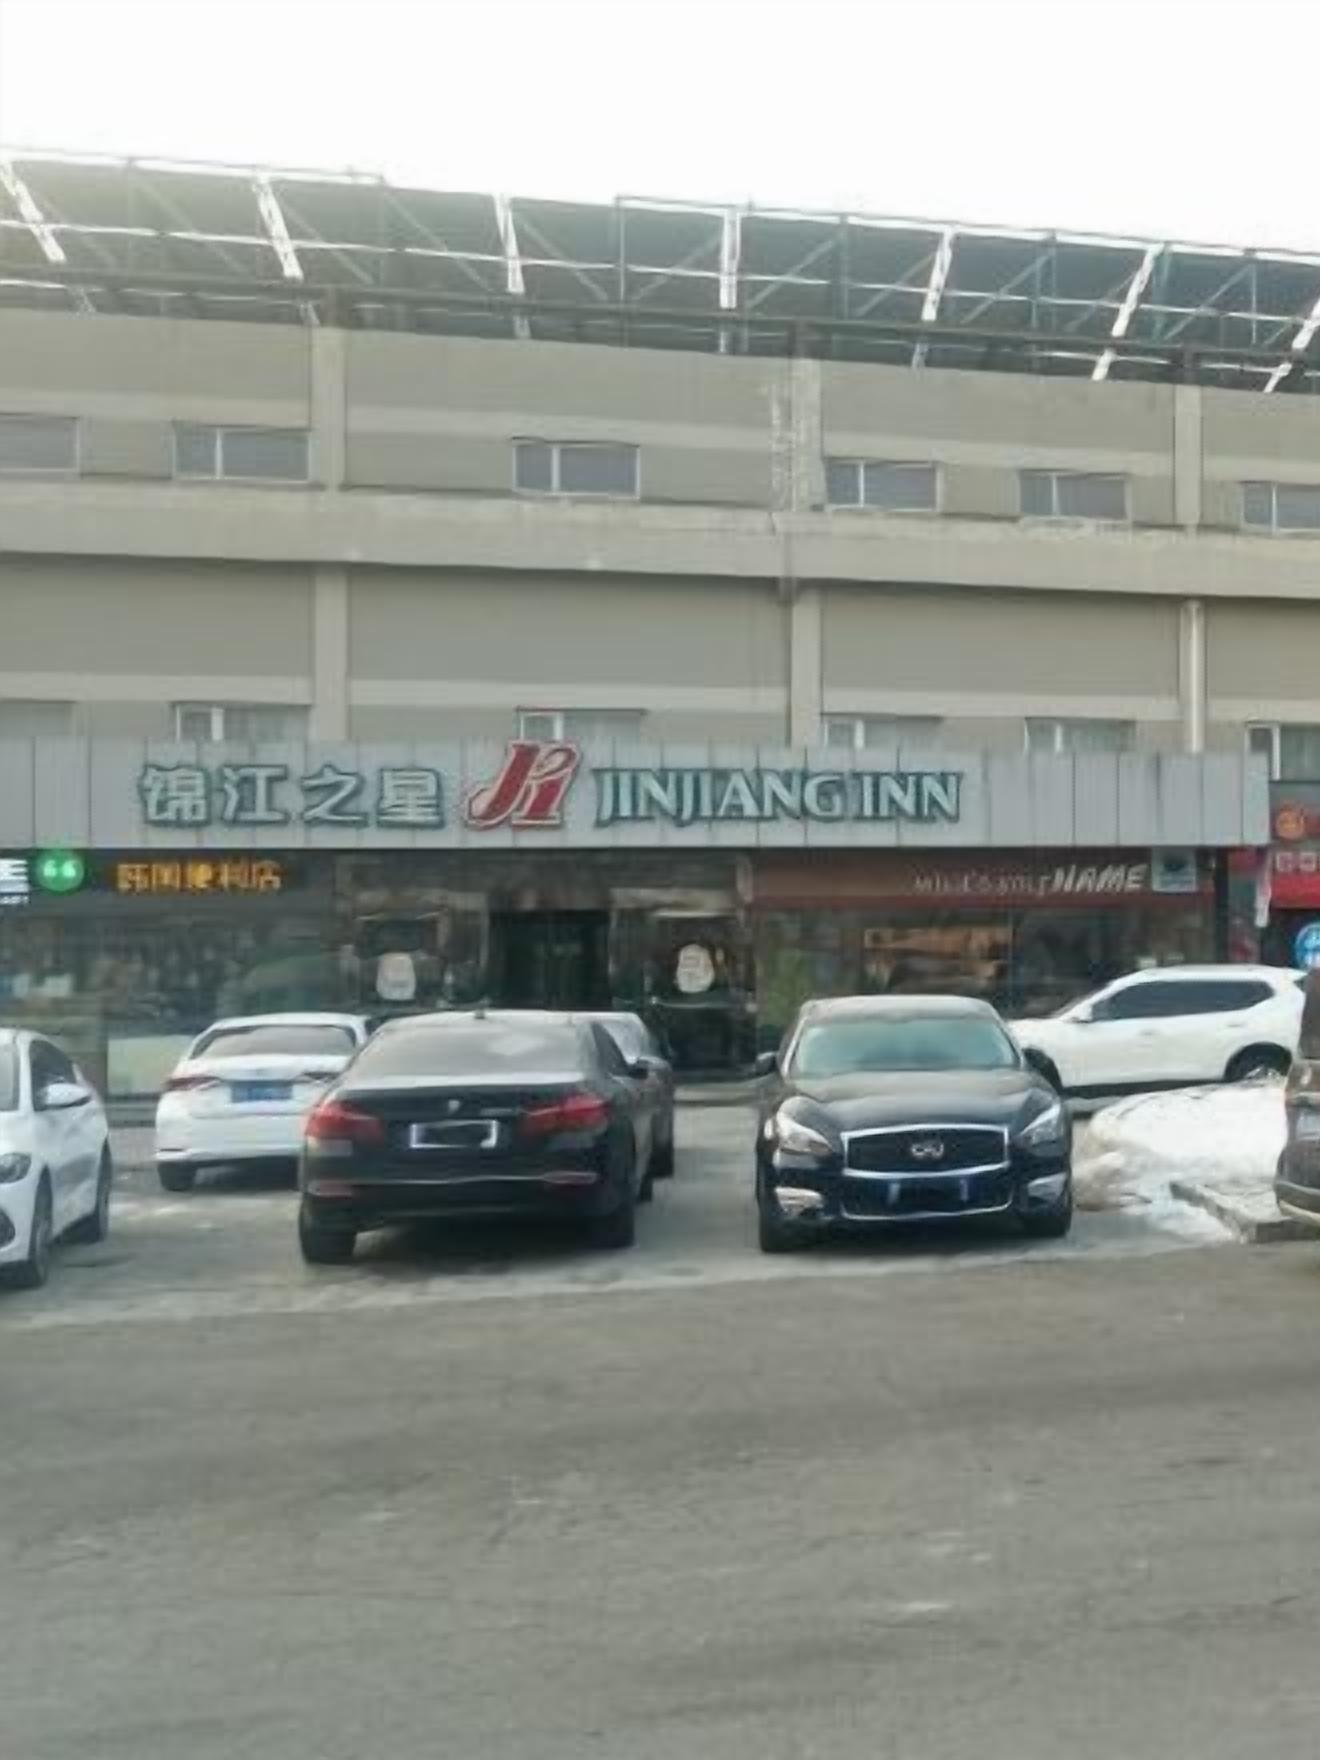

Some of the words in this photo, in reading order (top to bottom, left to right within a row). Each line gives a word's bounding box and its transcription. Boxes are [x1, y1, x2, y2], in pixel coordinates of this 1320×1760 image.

[141, 764, 444, 828] 锦江之星
[593, 767, 847, 826] JINJIANG
[850, 771, 963, 823] INN
